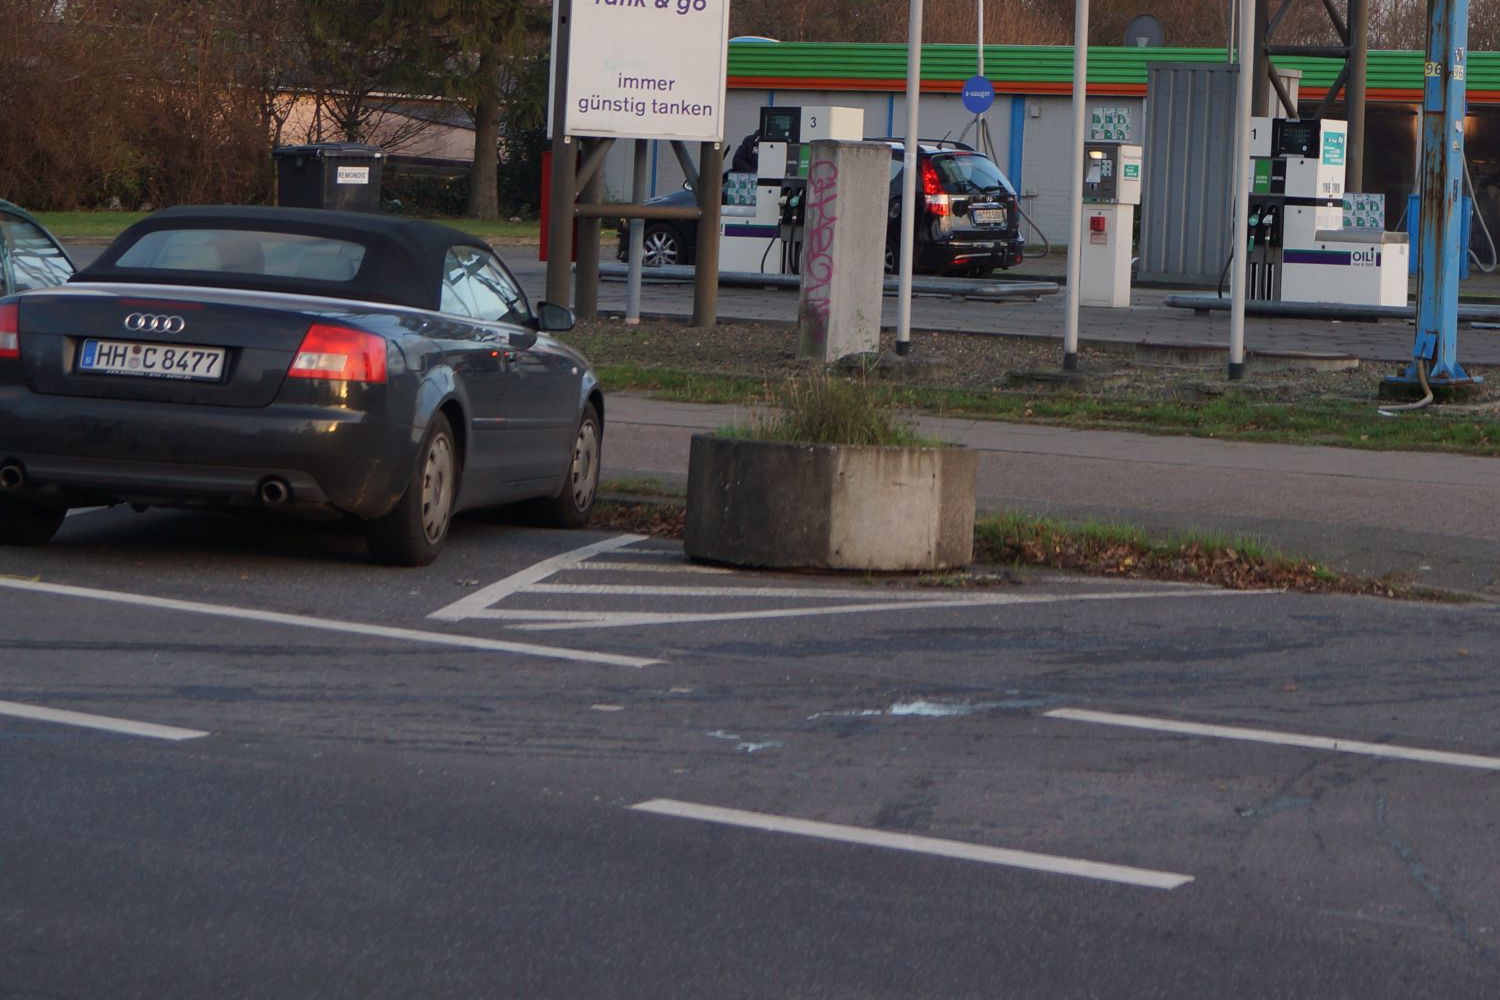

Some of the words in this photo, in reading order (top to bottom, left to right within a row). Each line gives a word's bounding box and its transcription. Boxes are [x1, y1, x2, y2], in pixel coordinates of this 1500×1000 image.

[1426, 63, 1441, 76] 96
[1454, 67, 1464, 79] 96
[618, 72, 676, 92] immer
[578, 95, 646, 117] günstig
[652, 99, 713, 117] tanken
[810, 116, 817, 128] 3
[1251, 128, 1257, 140] 1
[96, 344, 129, 368] HH
[143, 348, 157, 369] C
[161, 349, 219, 374] 8477
